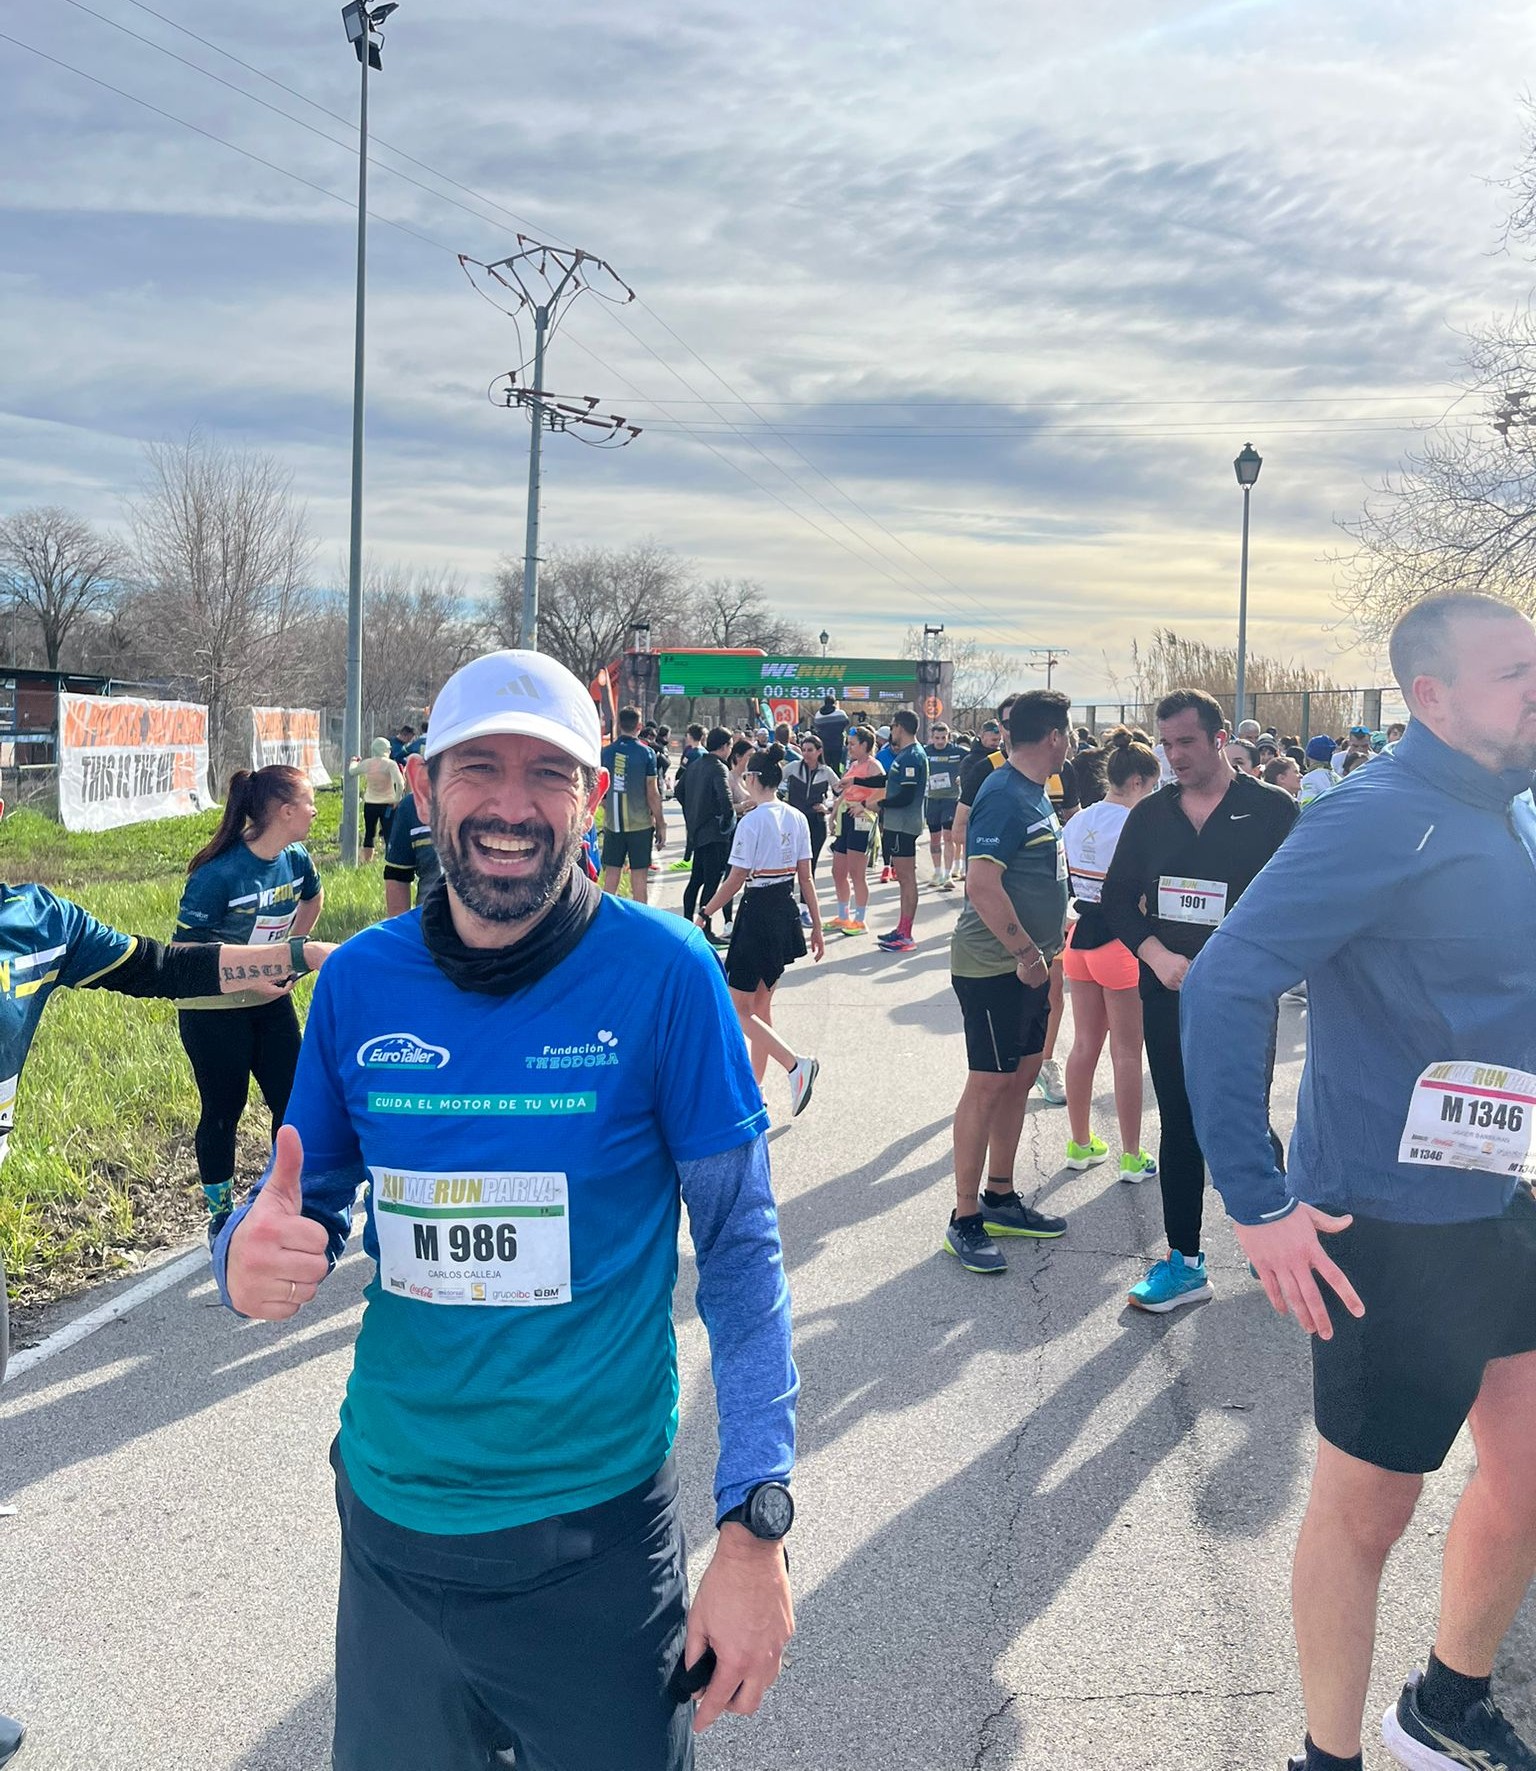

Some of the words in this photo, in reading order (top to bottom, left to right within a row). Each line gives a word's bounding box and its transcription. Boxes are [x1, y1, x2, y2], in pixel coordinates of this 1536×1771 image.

[760, 663, 848, 678] WERUN
[82, 755, 115, 803] THIS
[117, 755, 131, 798] IS
[134, 755, 156, 797] THE
[613, 752, 626, 792] WERUN
[259, 883, 294, 908] WERUN
[1180, 895, 1207, 910] 1901
[369, 1048, 435, 1063] EuroTaller
[543, 1043, 604, 1056] Fundación
[525, 1052, 619, 1069] THEODORA
[375, 1097, 412, 1109] CUIDA
[418, 1099, 433, 1109] EL
[440, 1100, 491, 1110] MOTOR
[499, 1099, 517, 1109] DE
[524, 1099, 542, 1109] TU
[550, 1097, 587, 1109] VIDA
[1441, 1095, 1464, 1123] M
[1468, 1100, 1524, 1132] 1346
[1410, 1148, 1418, 1158] M
[1420, 1149, 1443, 1160] 1346
[413, 1223, 439, 1261] M
[449, 1223, 518, 1263] 986
[428, 1270, 462, 1279] CARLOS
[464, 1271, 501, 1279] CALLEJA
[493, 1290, 530, 1300] grupoibc
